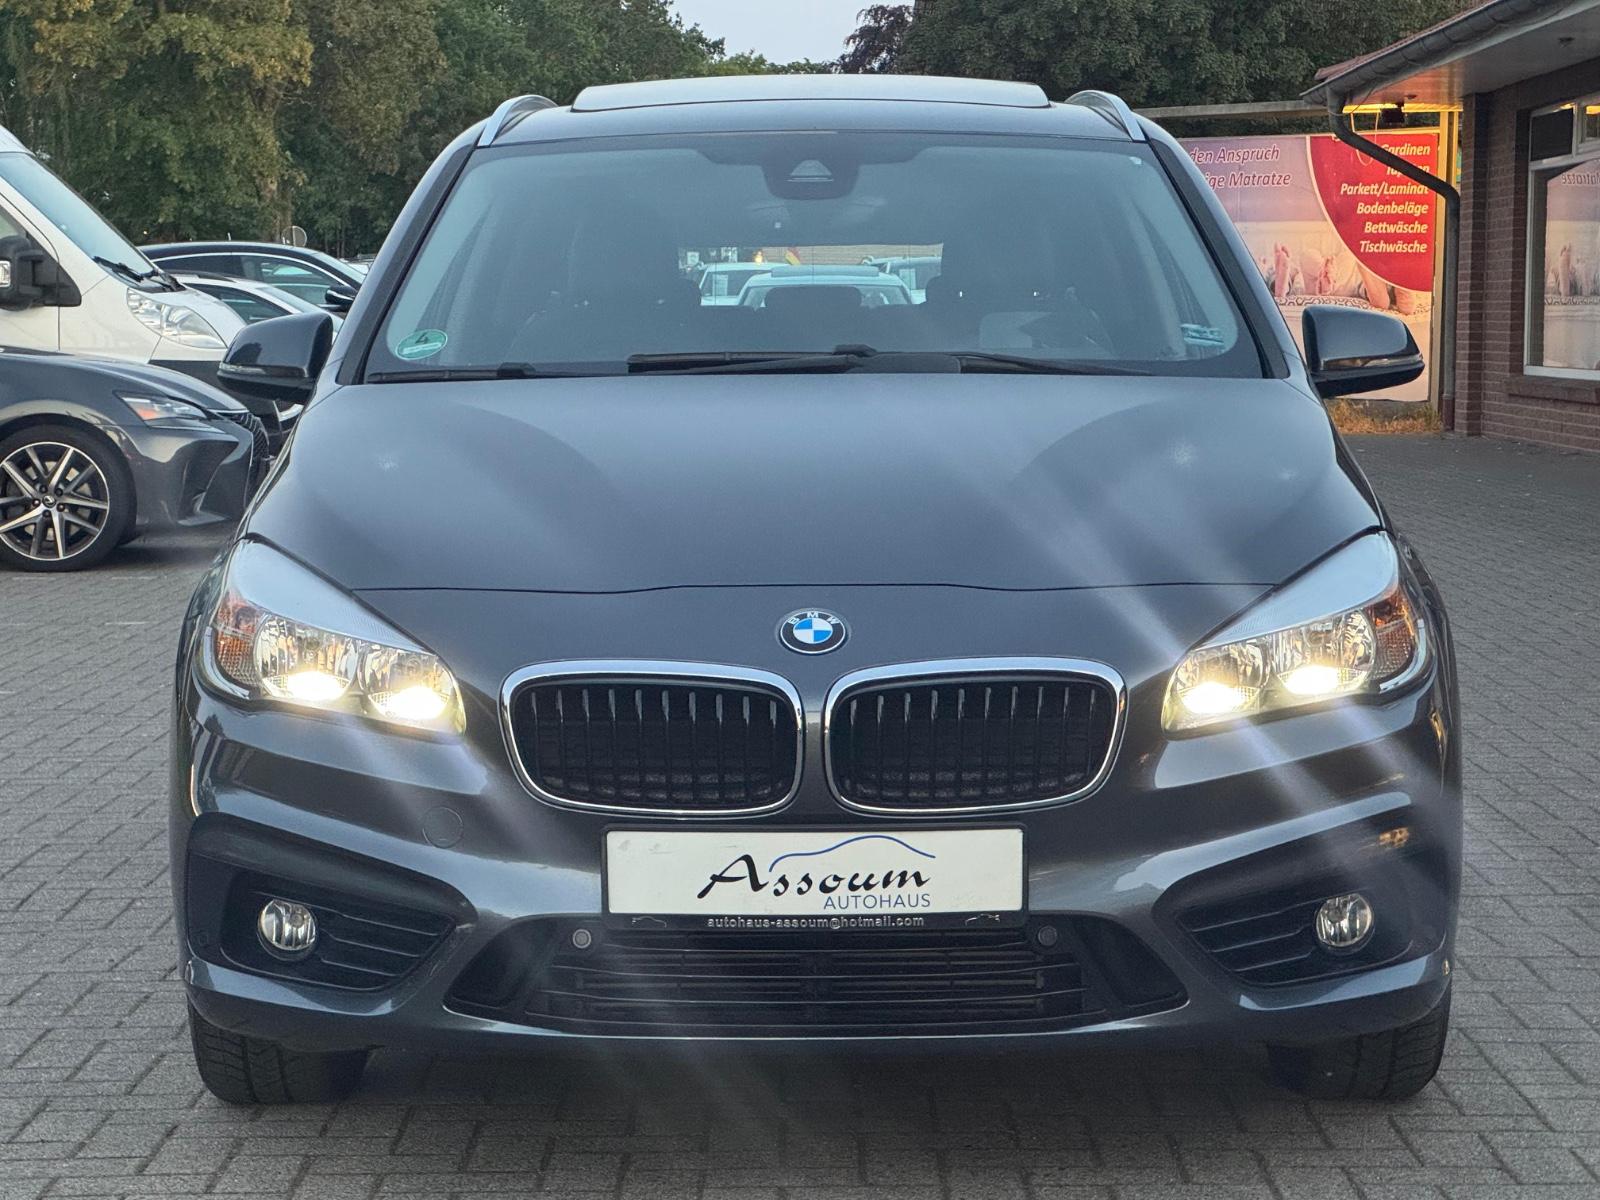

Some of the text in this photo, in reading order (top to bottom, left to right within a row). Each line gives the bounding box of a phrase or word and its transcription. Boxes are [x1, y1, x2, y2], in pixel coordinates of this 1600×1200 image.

[1216, 144, 1280, 164] Anspruch
[1229, 172, 1291, 187] Matratze
[1340, 181, 1429, 197] Parkett/Laminat
[1357, 201, 1429, 217] Bodenbeläge
[1364, 220, 1428, 234] Bettwäsche
[1359, 240, 1428, 253] Tischwäsche
[787, 611, 841, 625] BMW
[697, 854, 931, 899] Assoum
[823, 893, 931, 910] AUTOHAUS
[707, 915, 925, 930] autohaus-assoum@hotmail.com
